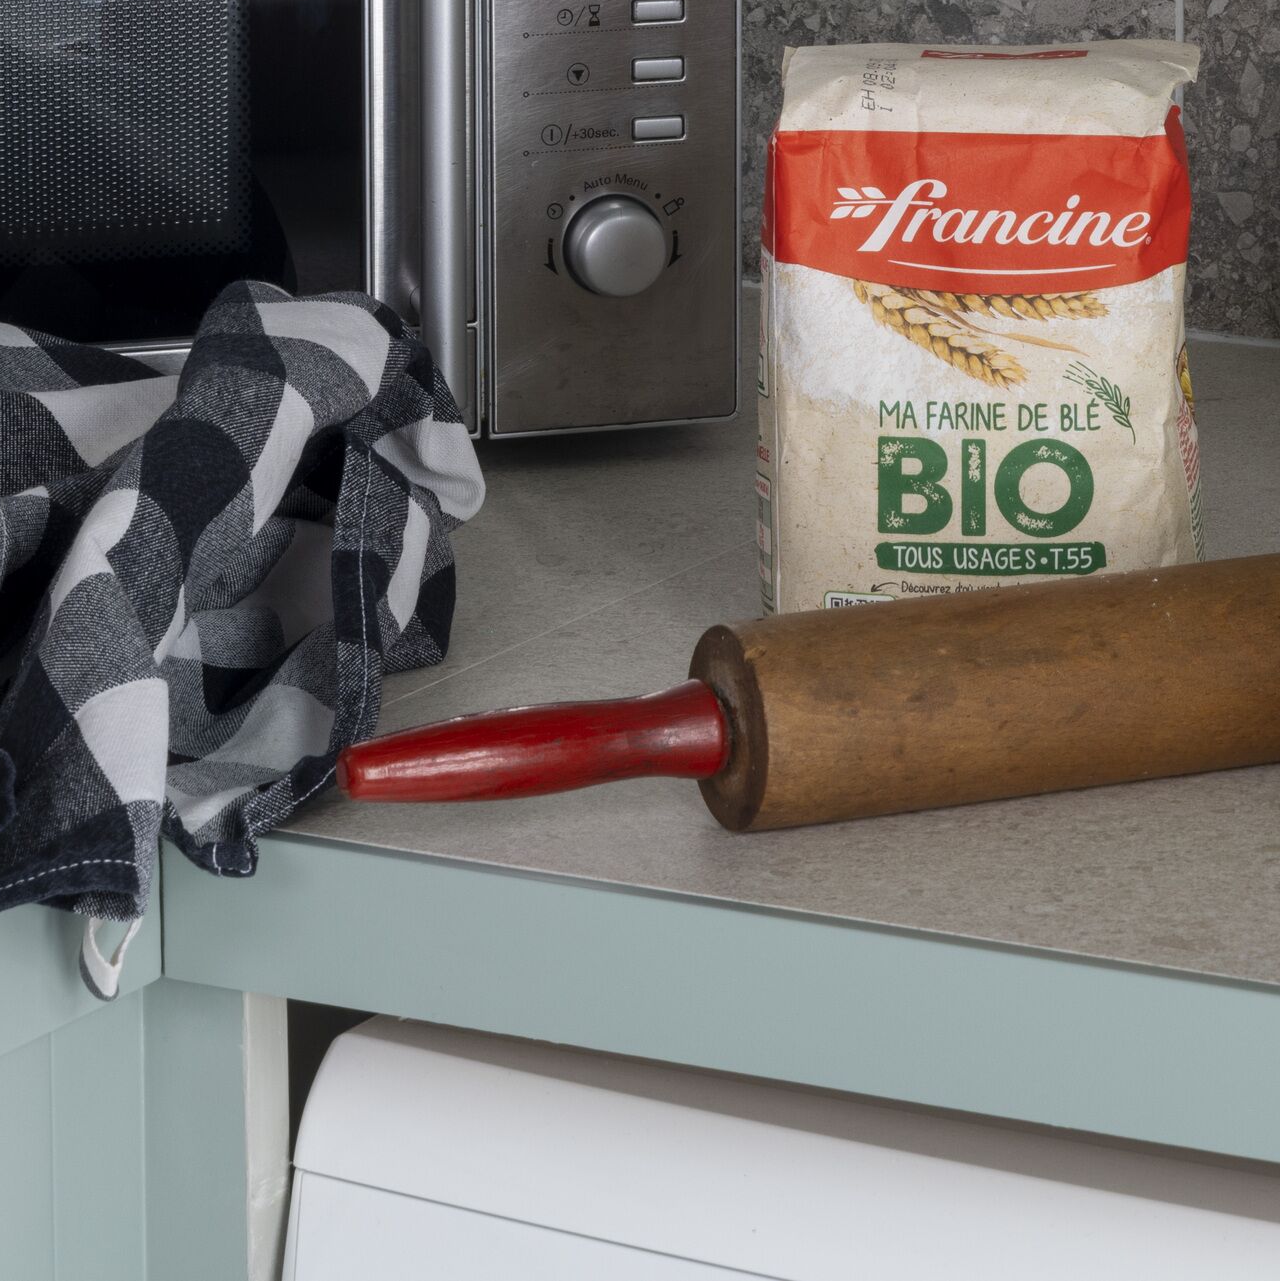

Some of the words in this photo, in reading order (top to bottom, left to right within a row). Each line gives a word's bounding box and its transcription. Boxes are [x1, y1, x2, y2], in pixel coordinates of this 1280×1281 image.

[583, 176, 612, 192] Auto
[615, 173, 649, 191] Menu
[857, 179, 1151, 252] francine
[879, 399, 917, 429] MA
[926, 401, 1007, 431] FARINE
[1018, 402, 1049, 431] DE
[1060, 398, 1101, 432] BLÉ
[877, 435, 1095, 538] BIO
[892, 545, 944, 569] TOUS
[901, 580, 951, 594] Découvrez
